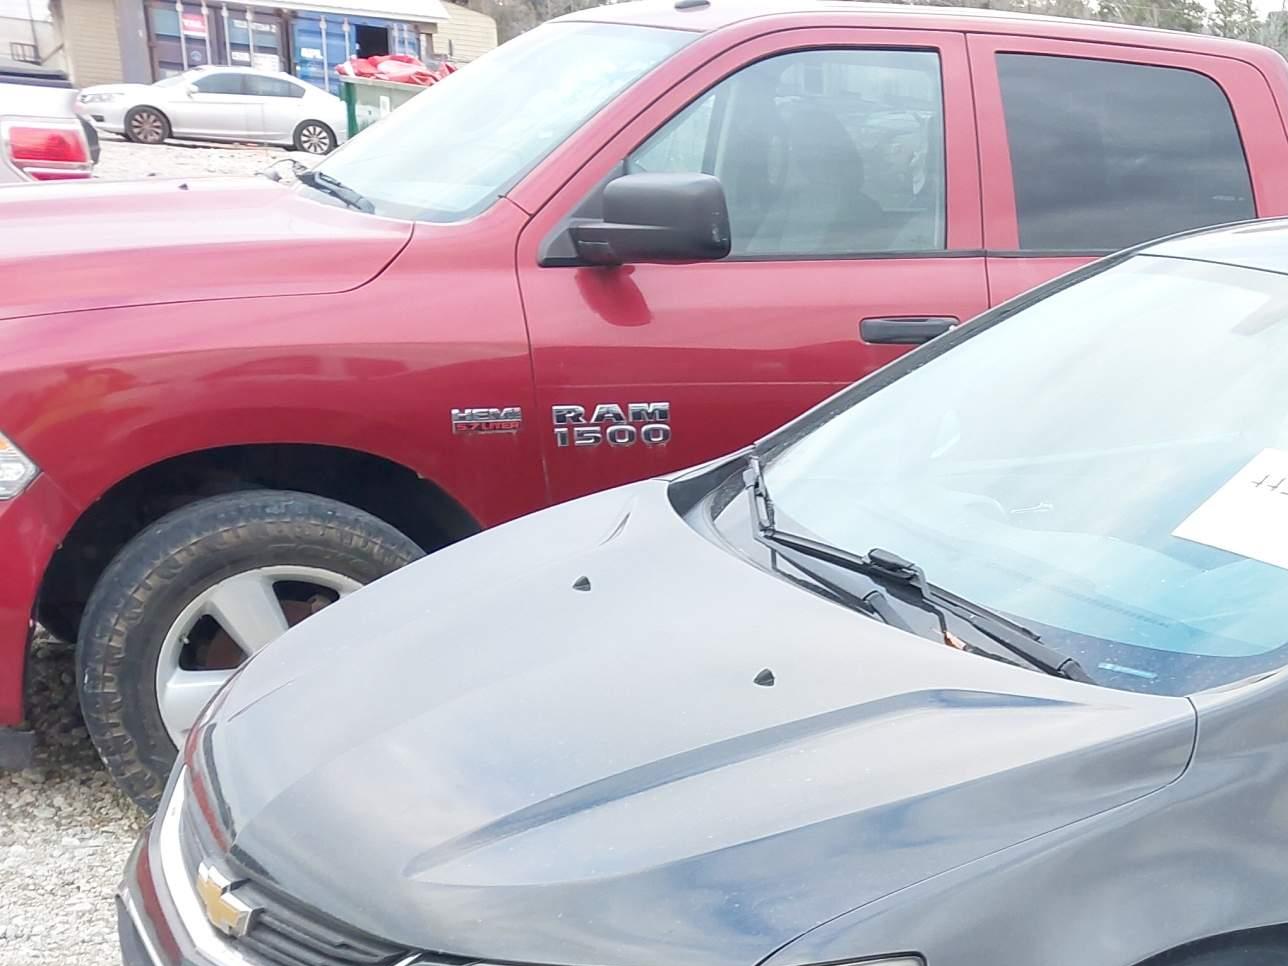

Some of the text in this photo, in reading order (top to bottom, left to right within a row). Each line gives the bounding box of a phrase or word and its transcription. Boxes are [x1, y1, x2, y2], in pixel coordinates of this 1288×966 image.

[451, 407, 521, 421] HEMI
[552, 402, 670, 426] RAM
[554, 424, 671, 447] 1500
